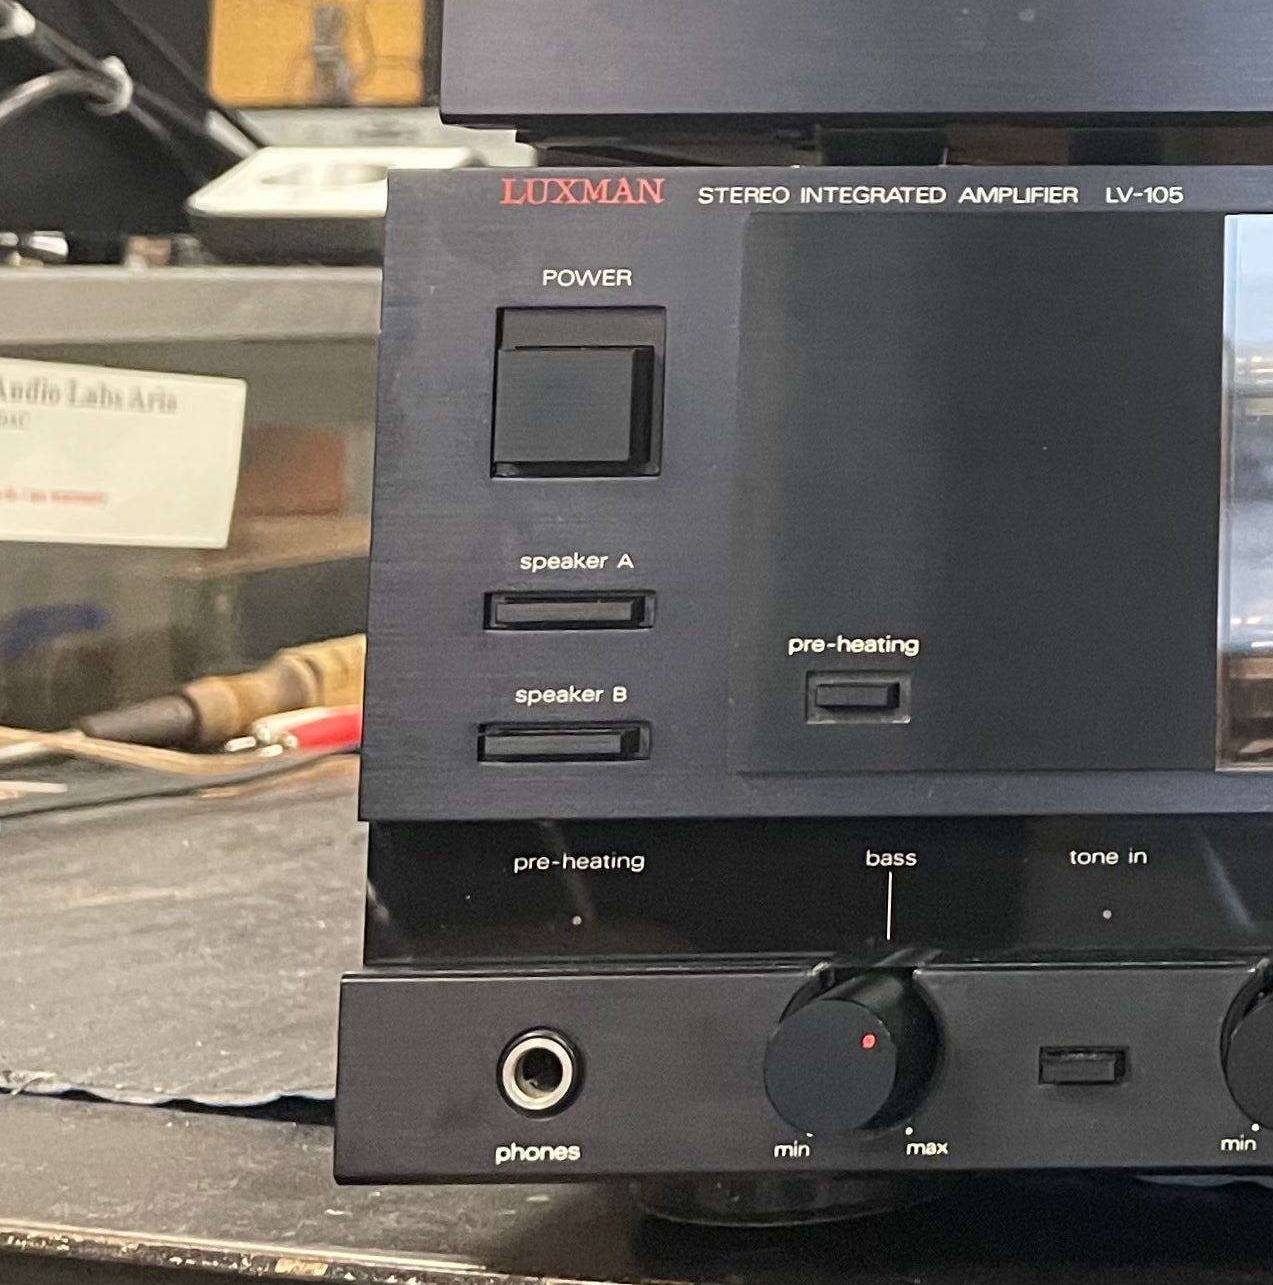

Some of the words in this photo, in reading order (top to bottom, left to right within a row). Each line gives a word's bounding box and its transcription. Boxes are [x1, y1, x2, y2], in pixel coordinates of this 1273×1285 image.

[501, 177, 664, 205] LUXMAN
[698, 187, 790, 204] STEREO
[801, 186, 946, 203] INTEGRATED
[958, 187, 1078, 203] AMPLIFIER
[1106, 187, 1183, 203] LV-105
[543, 269, 631, 286] POWER
[521, 552, 608, 572] speaker
[617, 554, 634, 568] A
[789, 635, 919, 656] pre-heating
[515, 686, 604, 706] speaker
[613, 687, 627, 702] B
[514, 853, 644, 873] pre-heating
[866, 850, 917, 866] bass
[1070, 851, 1118, 864] tone
[1129, 852, 1147, 863] in
[774, 1141, 809, 1157] min
[907, 1142, 948, 1155] max
[1221, 1139, 1256, 1150] min
[496, 1143, 580, 1165] phones
